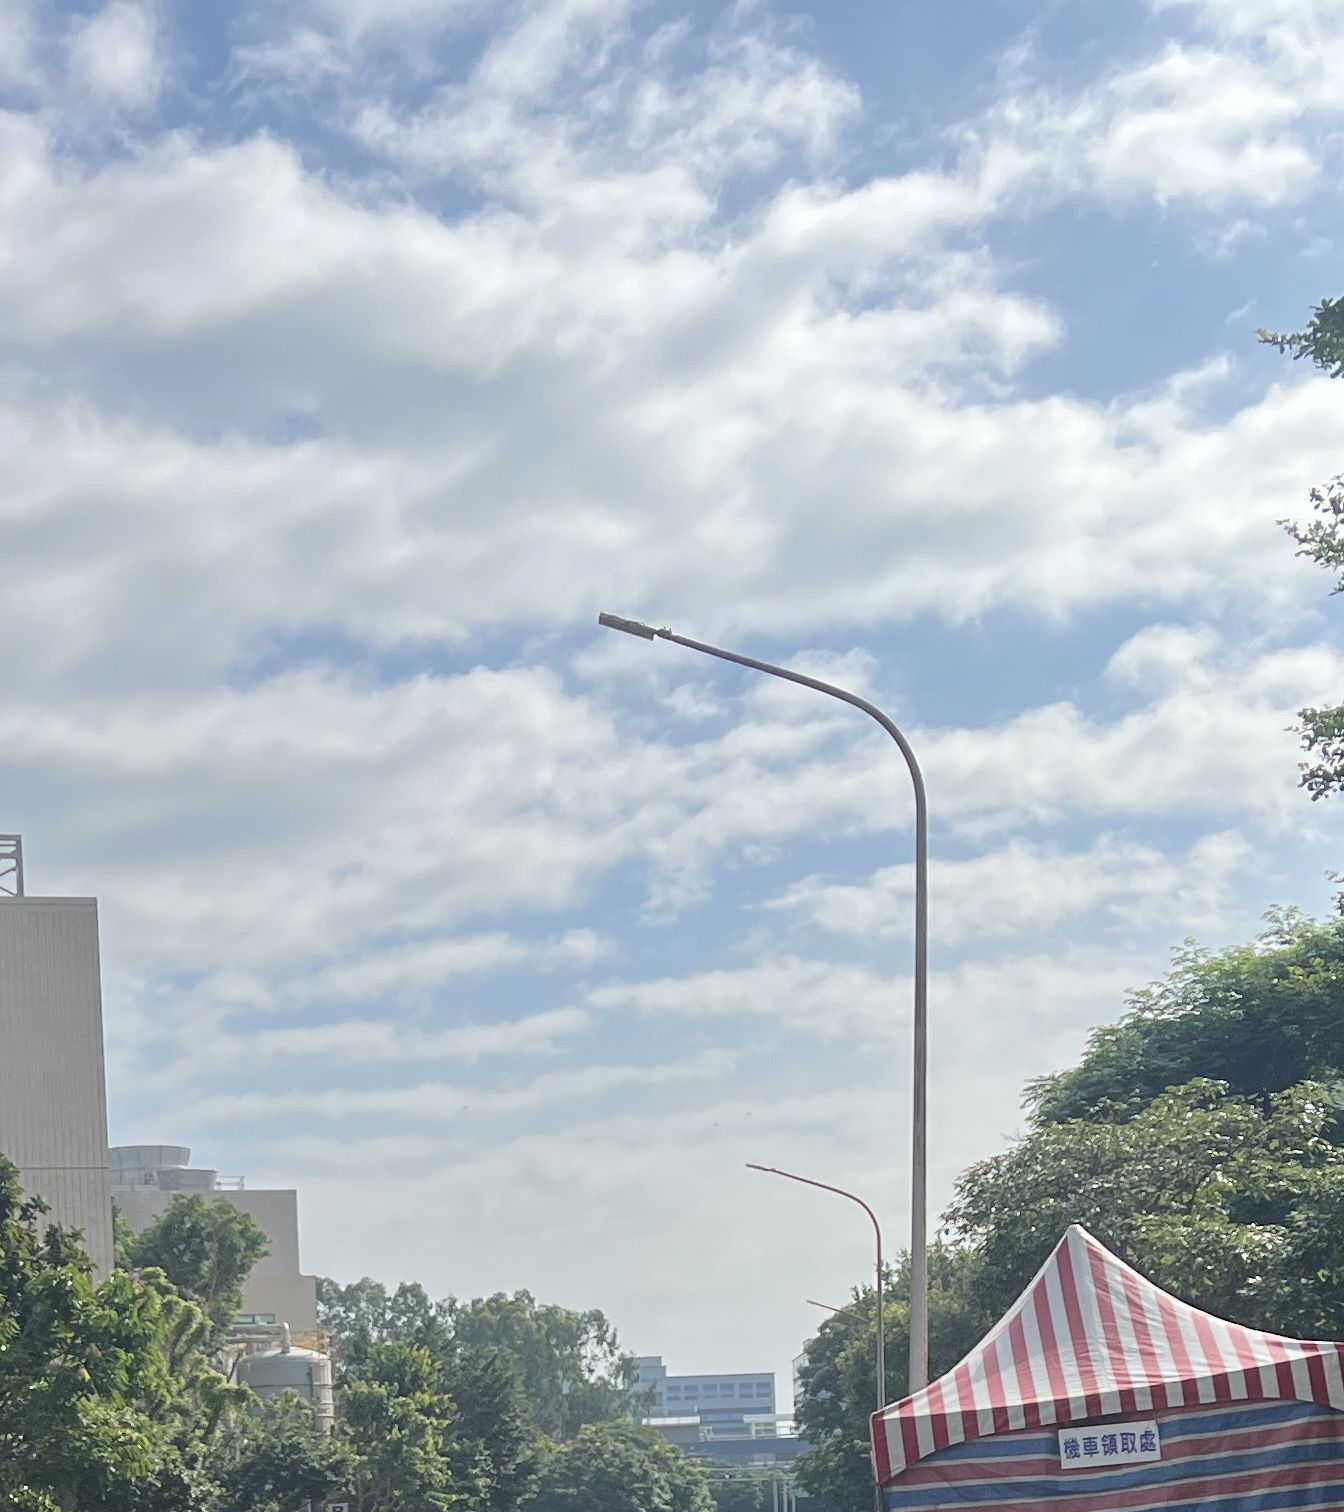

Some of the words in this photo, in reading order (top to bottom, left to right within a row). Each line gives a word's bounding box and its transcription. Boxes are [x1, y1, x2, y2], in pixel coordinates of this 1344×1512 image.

[1064, 1430, 1157, 1460] 機車領取處
